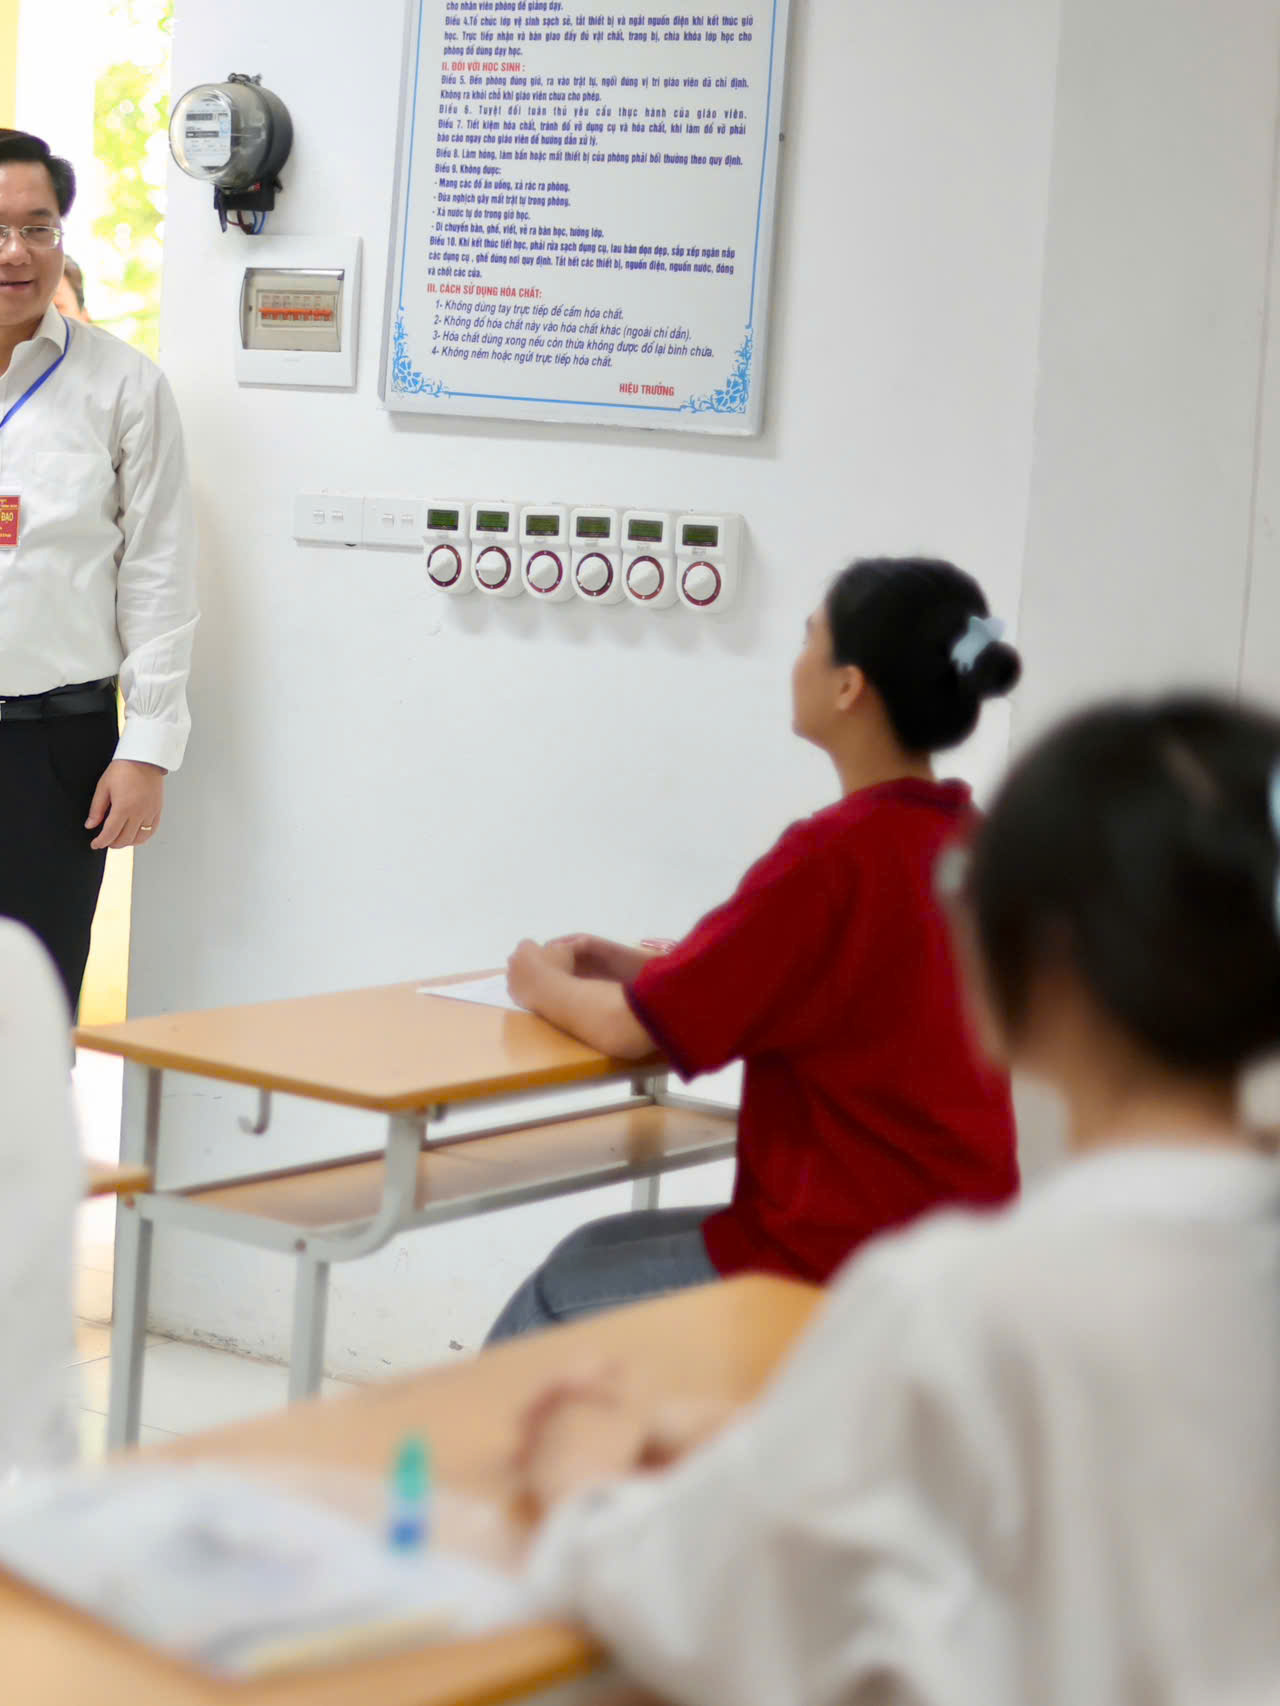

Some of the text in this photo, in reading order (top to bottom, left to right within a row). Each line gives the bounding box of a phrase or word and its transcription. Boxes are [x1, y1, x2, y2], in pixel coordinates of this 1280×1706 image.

[618, 382, 675, 396] HIỆU TRƯỞNG
[1, 512, 14, 524] ĐẠO
